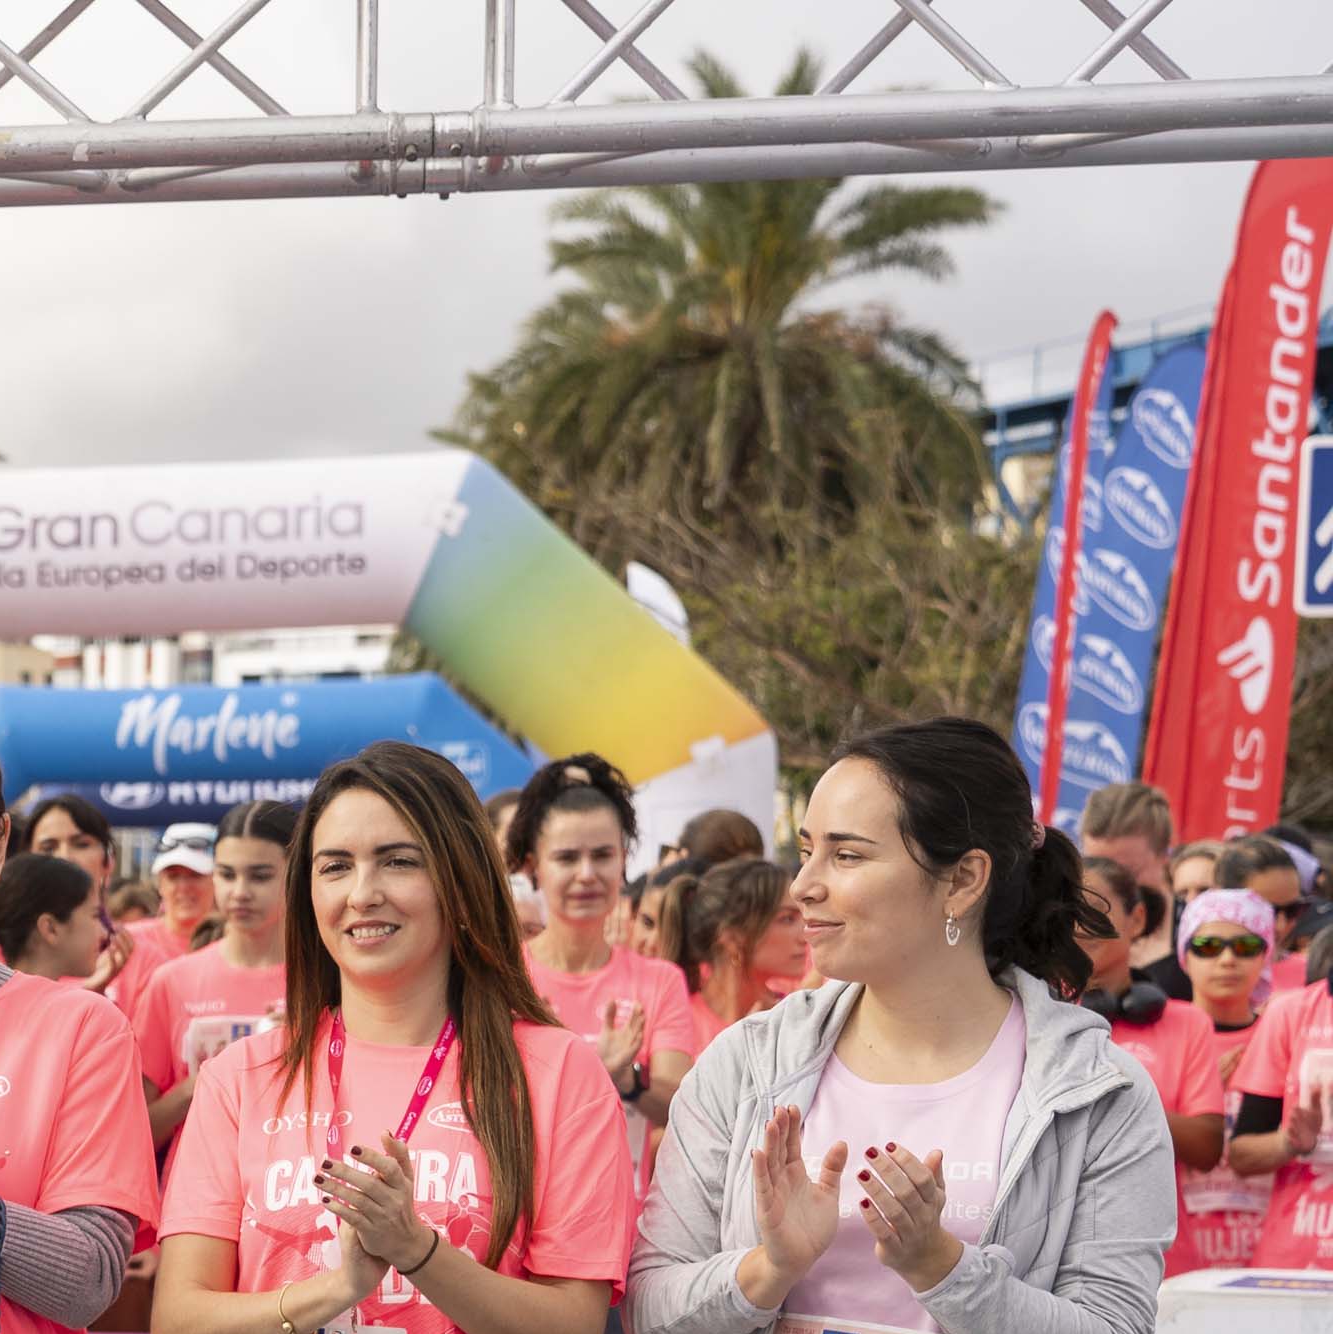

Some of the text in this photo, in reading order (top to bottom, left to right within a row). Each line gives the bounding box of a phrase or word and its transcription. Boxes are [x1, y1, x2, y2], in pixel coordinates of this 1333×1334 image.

[1237, 207, 1315, 606] Santander
[132, 494, 364, 546] Canaria
[37, 558, 166, 591] Europea
[176, 554, 224, 583] del
[236, 550, 367, 583] Deporte
[115, 692, 300, 775] Marlene
[262, 1111, 354, 1135] OYSHO
